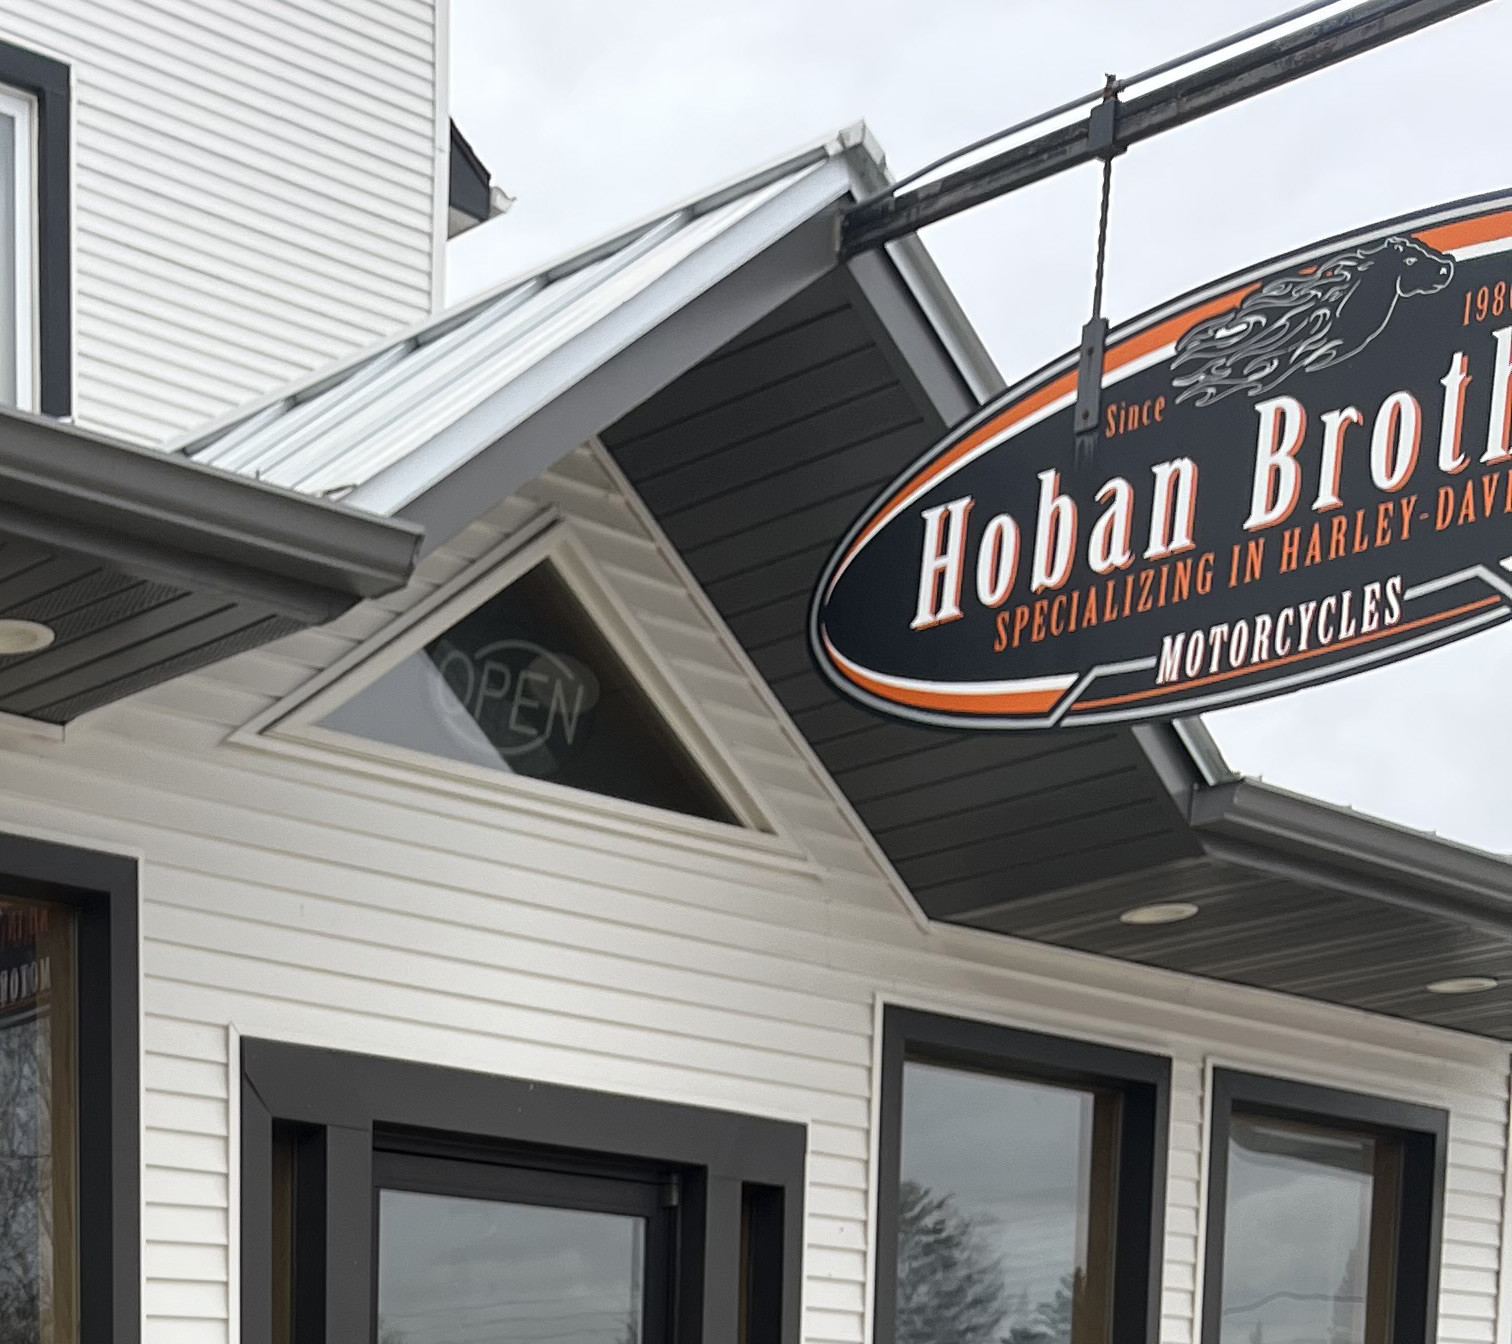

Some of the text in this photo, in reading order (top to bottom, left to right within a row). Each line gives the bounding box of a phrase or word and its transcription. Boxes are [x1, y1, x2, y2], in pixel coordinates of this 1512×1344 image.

[1105, 280, 1512, 438] Since 198
[909, 454, 1201, 632] Hoban
[993, 553, 1214, 653] SPECIALIZING
[1228, 544, 1262, 588] IN
[1156, 575, 1403, 685] MOTORCYCLES
[438, 648, 585, 746] OPEN
